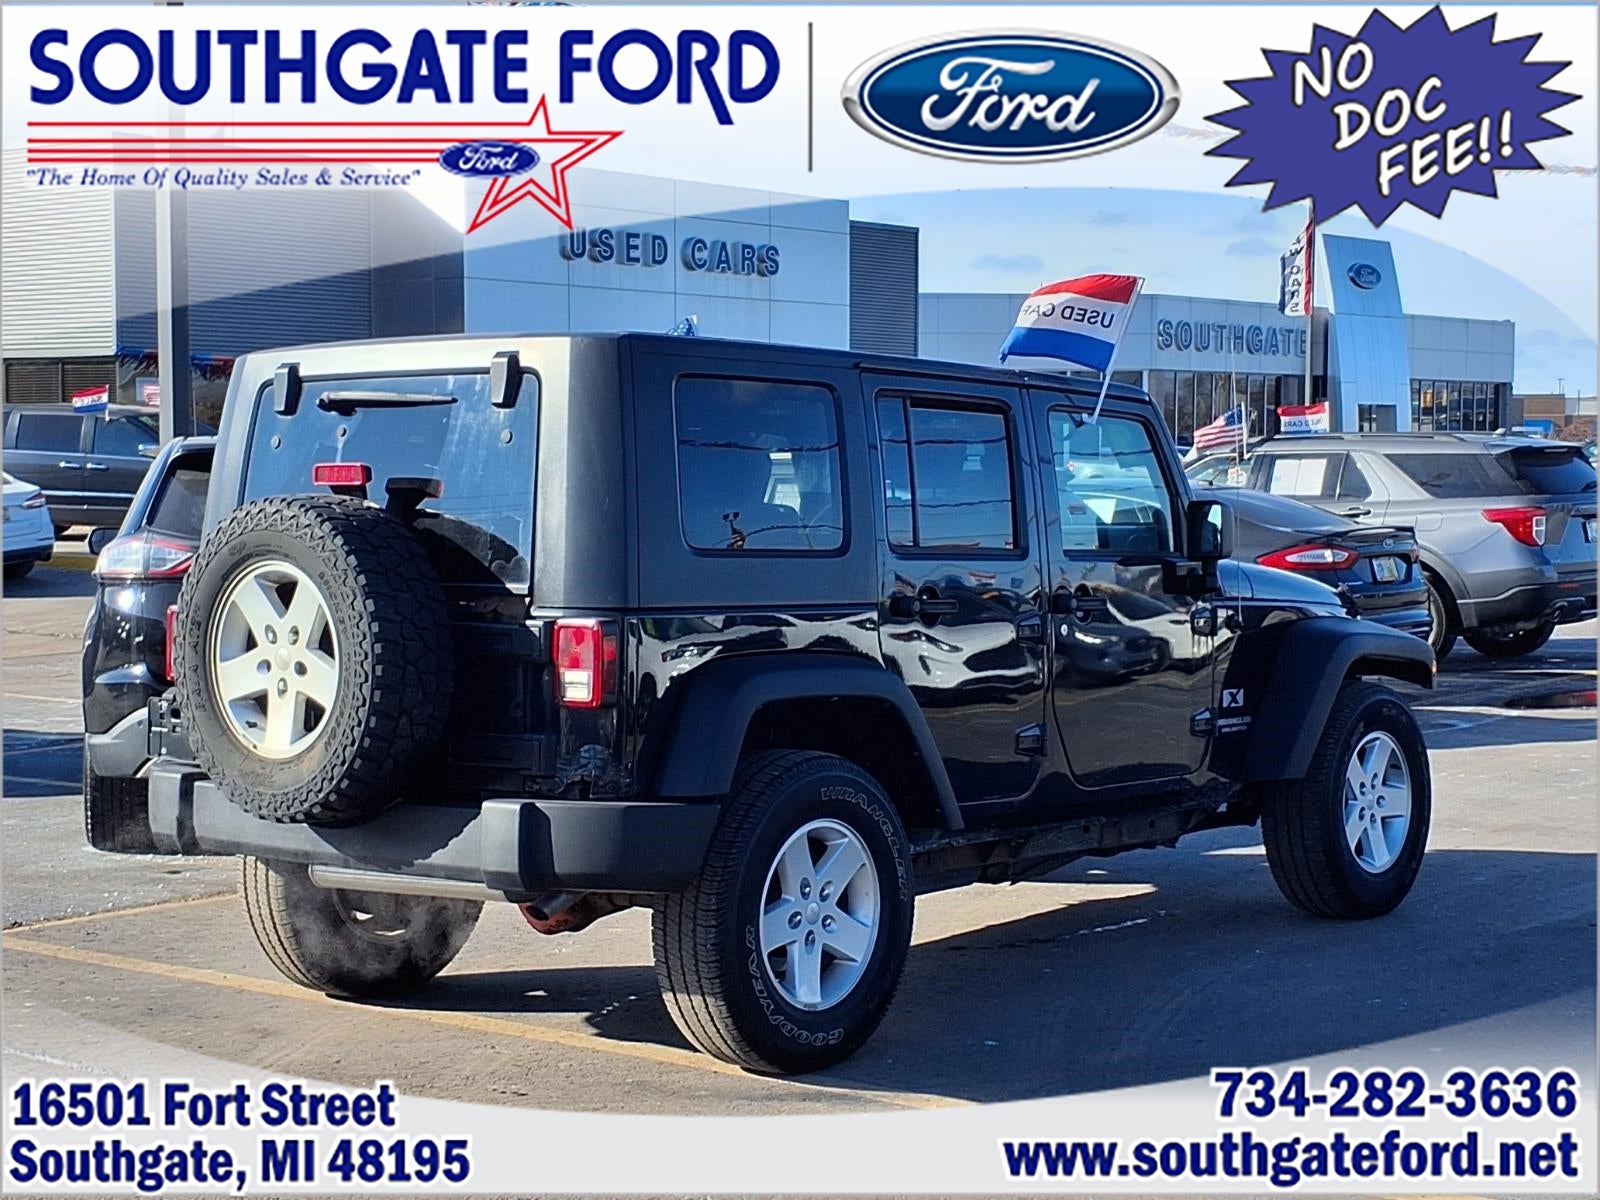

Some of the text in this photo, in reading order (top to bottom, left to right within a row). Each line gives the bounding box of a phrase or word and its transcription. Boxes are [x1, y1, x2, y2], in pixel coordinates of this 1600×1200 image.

[560, 228, 780, 277] USED CARS
[1158, 319, 1307, 357] SOUTHGATE
[820, 786, 910, 900] WRANGLER
[745, 925, 844, 1046] GOODYEAR
